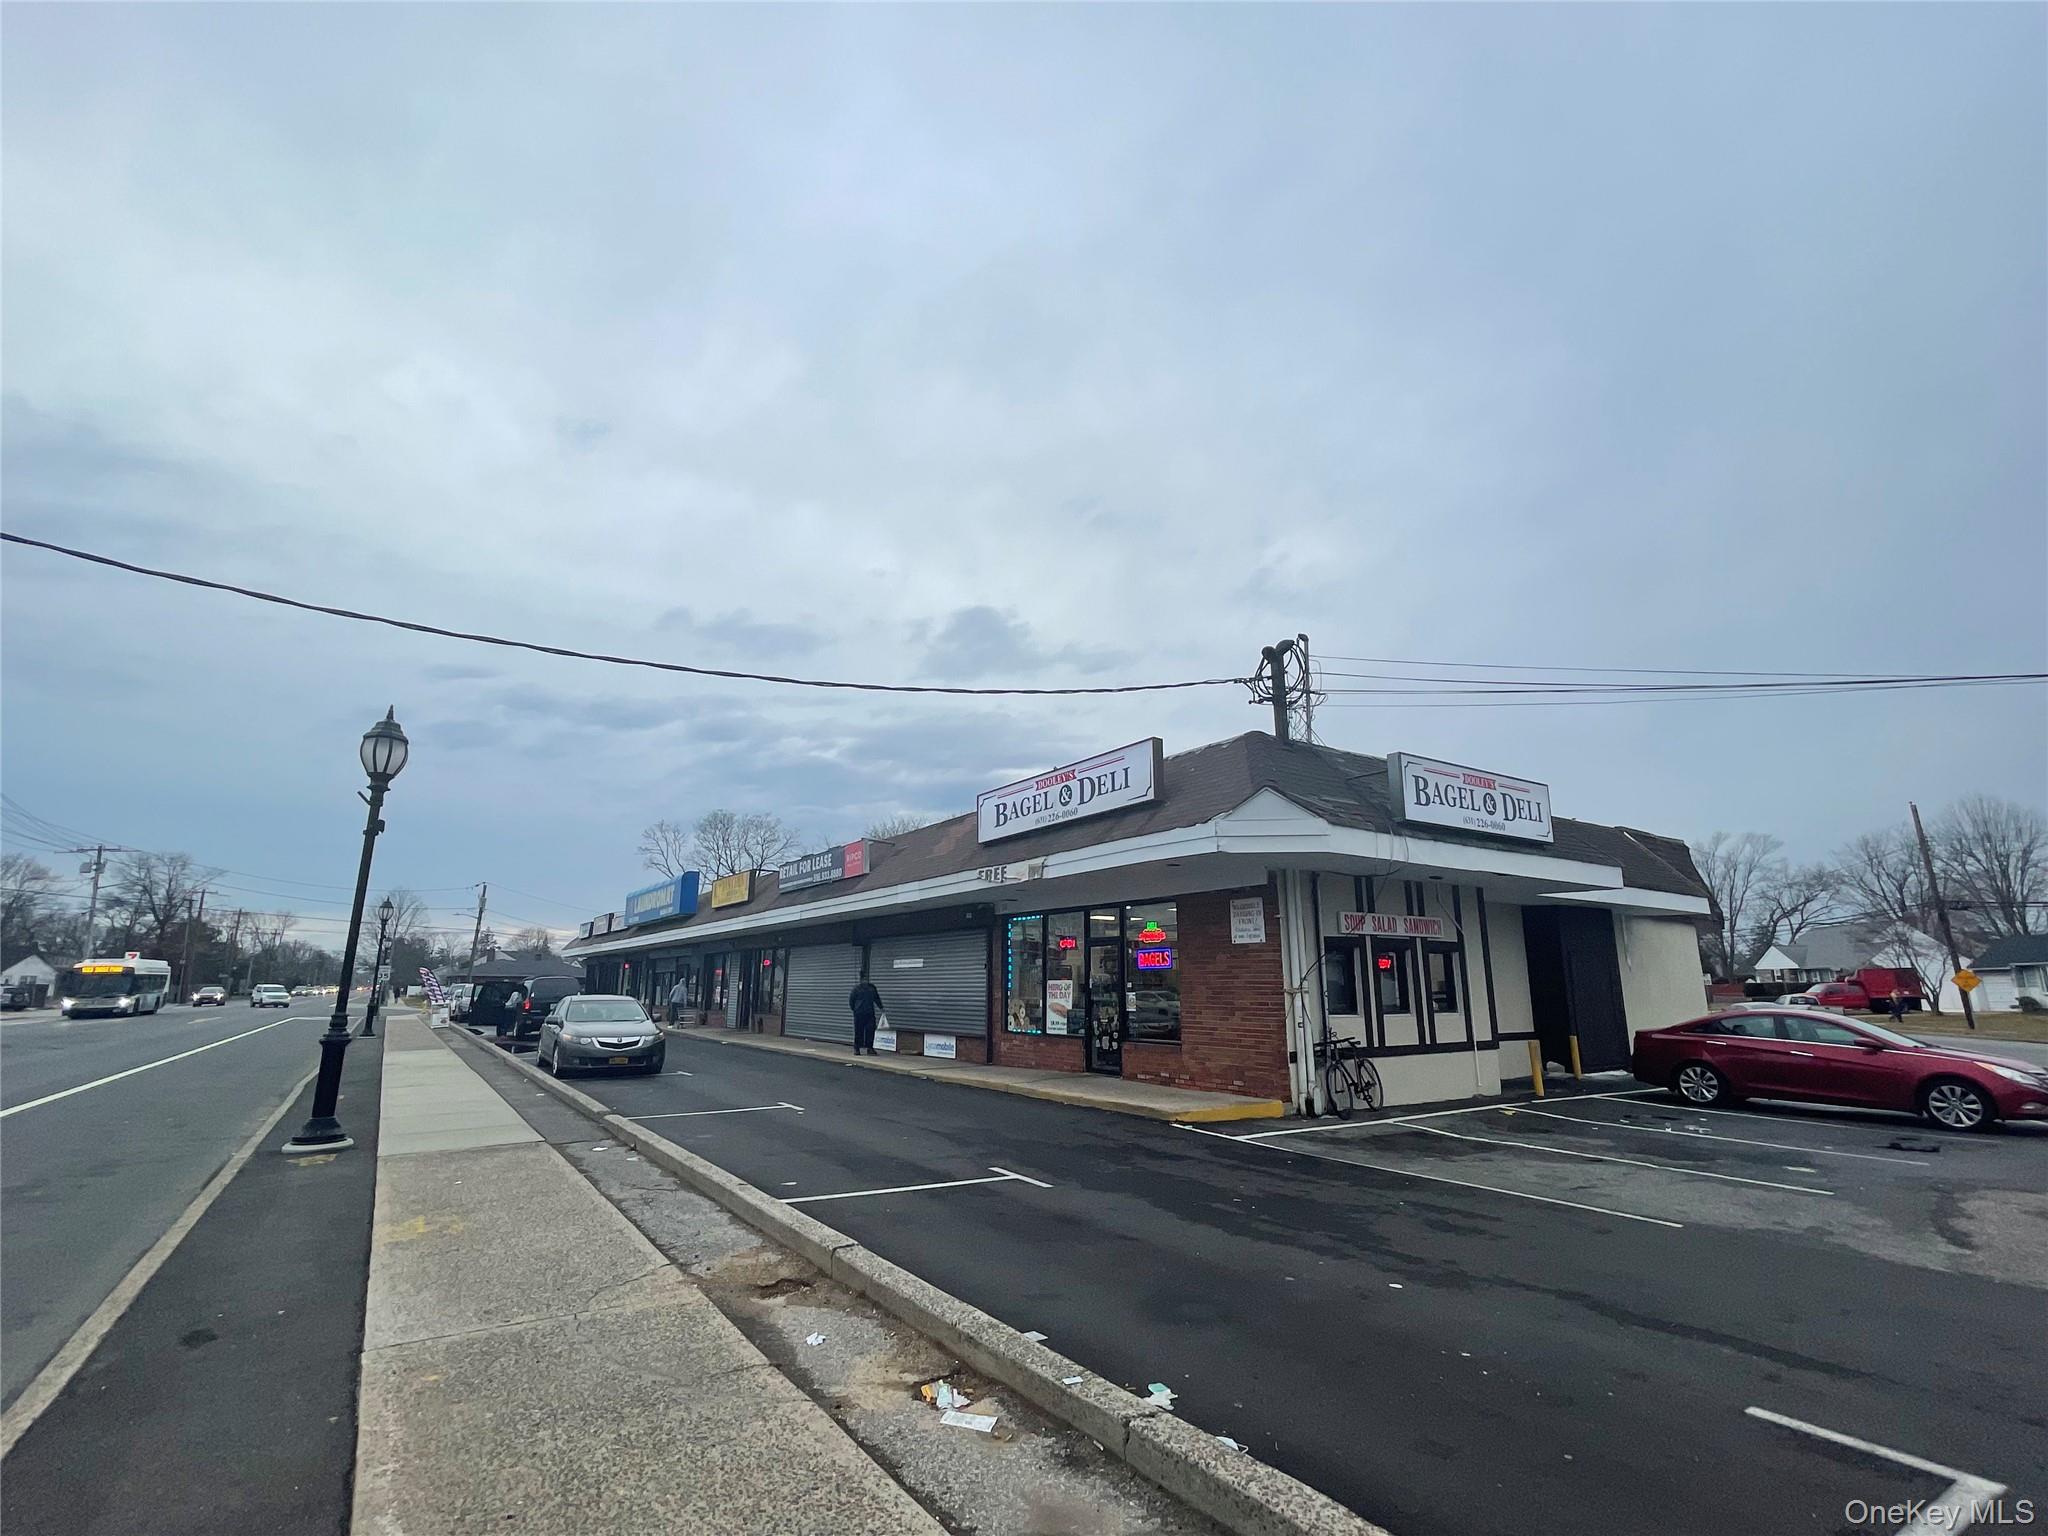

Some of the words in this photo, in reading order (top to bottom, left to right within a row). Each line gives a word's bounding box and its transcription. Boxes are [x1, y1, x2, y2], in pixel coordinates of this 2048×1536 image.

[1038, 770, 1074, 790] DOOLEY'S
[995, 791, 1054, 828] BAGEL
[1060, 785, 1072, 804] &
[1077, 767, 1130, 805] DELI
[1412, 775, 1480, 811] BAGEL
[1484, 794, 1496, 814] &
[1501, 792, 1543, 823] DELI
[1048, 807, 1078, 824] 226-0060
[1477, 818, 1505, 831] 226-0060
[779, 863, 798, 879] RETAIL
[799, 859, 811, 874] FOR
[812, 853, 832, 871] LEASE
[977, 866, 1007, 883] FREE
[1344, 913, 1366, 932] SOUP
[1372, 916, 1397, 933] SALAD
[1404, 917, 1442, 936] SANDWICH
[1138, 951, 1170, 967] BAGELS
[1059, 991, 1071, 999] DAY
